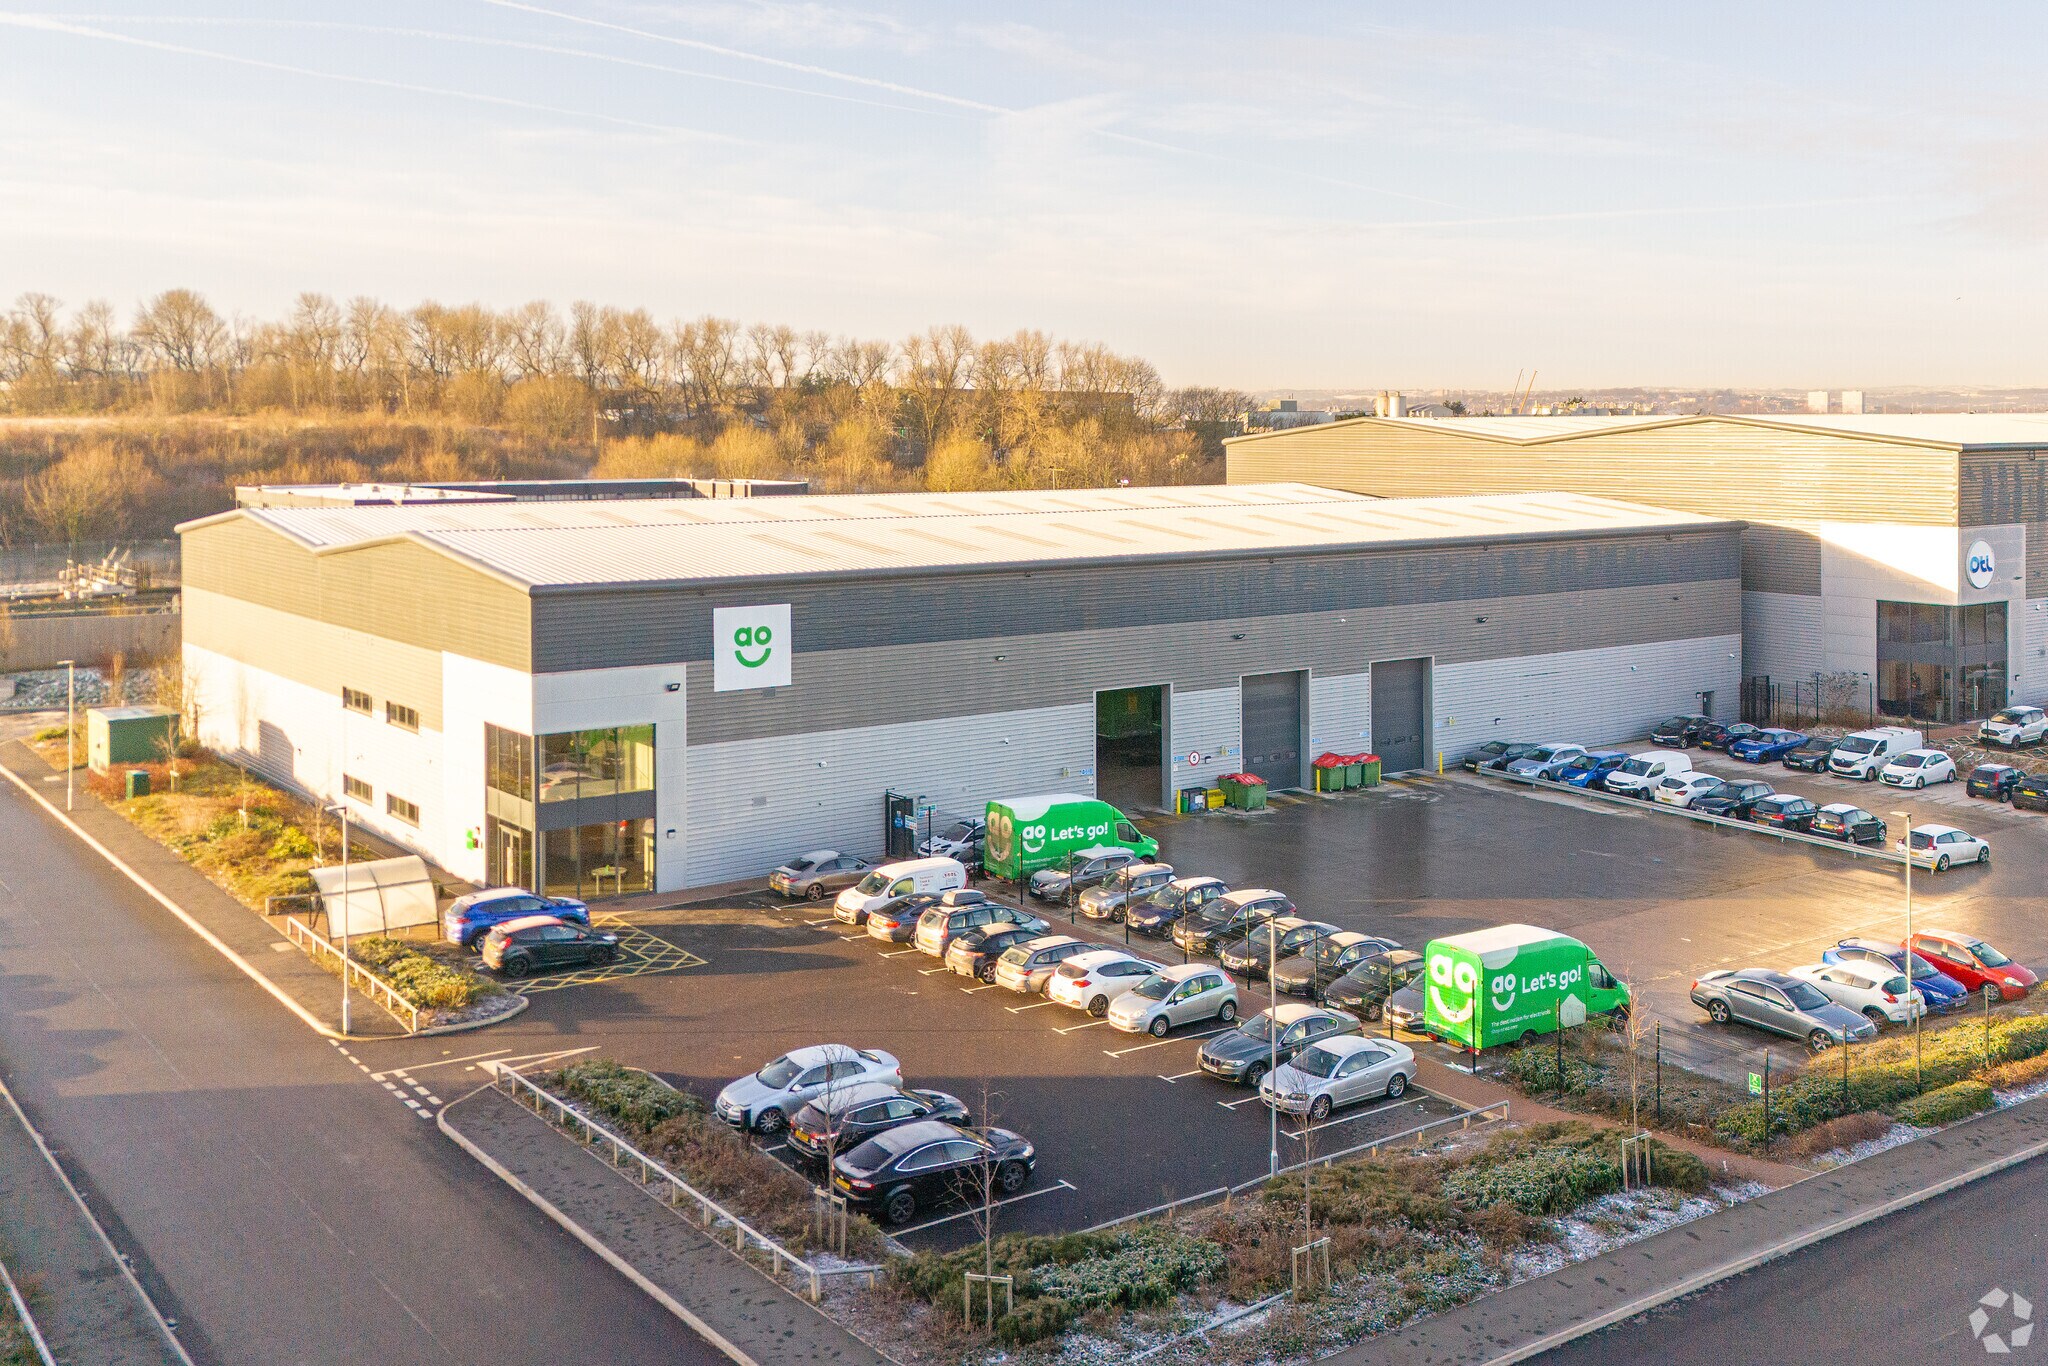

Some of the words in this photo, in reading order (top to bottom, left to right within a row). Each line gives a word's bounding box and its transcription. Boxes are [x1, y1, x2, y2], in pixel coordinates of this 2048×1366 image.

[734, 626, 771, 647] ao
[987, 811, 1012, 838] ao
[1023, 825, 1046, 839] ao
[1051, 825, 1084, 841] Let's
[1087, 822, 1109, 841] go!
[1430, 954, 1477, 993] ao
[1492, 973, 1516, 994] ao
[1522, 971, 1556, 994] Let's
[1559, 964, 1582, 990] go!
